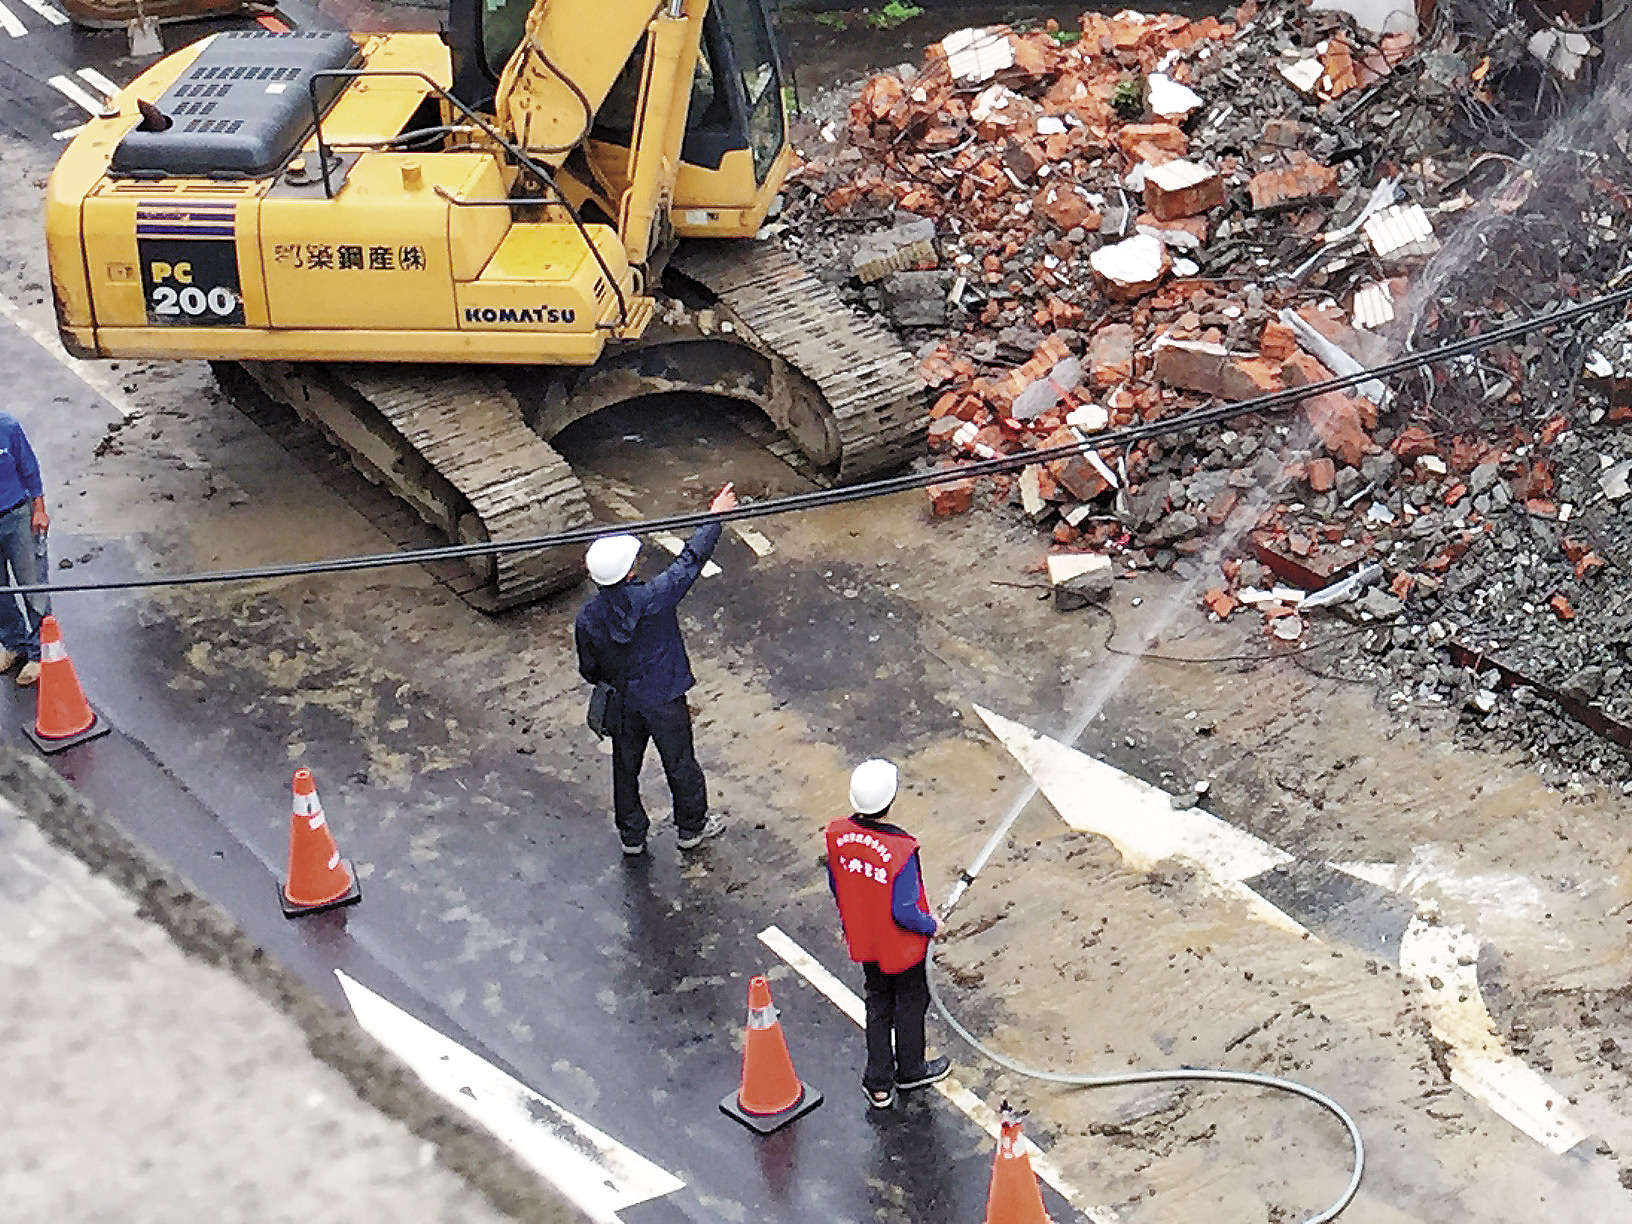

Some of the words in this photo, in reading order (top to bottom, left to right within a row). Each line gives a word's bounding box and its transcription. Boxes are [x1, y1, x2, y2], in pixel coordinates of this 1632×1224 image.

[150, 261, 193, 284] PC
[152, 286, 236, 316] 200
[464, 306, 576, 325] KOMATSU
